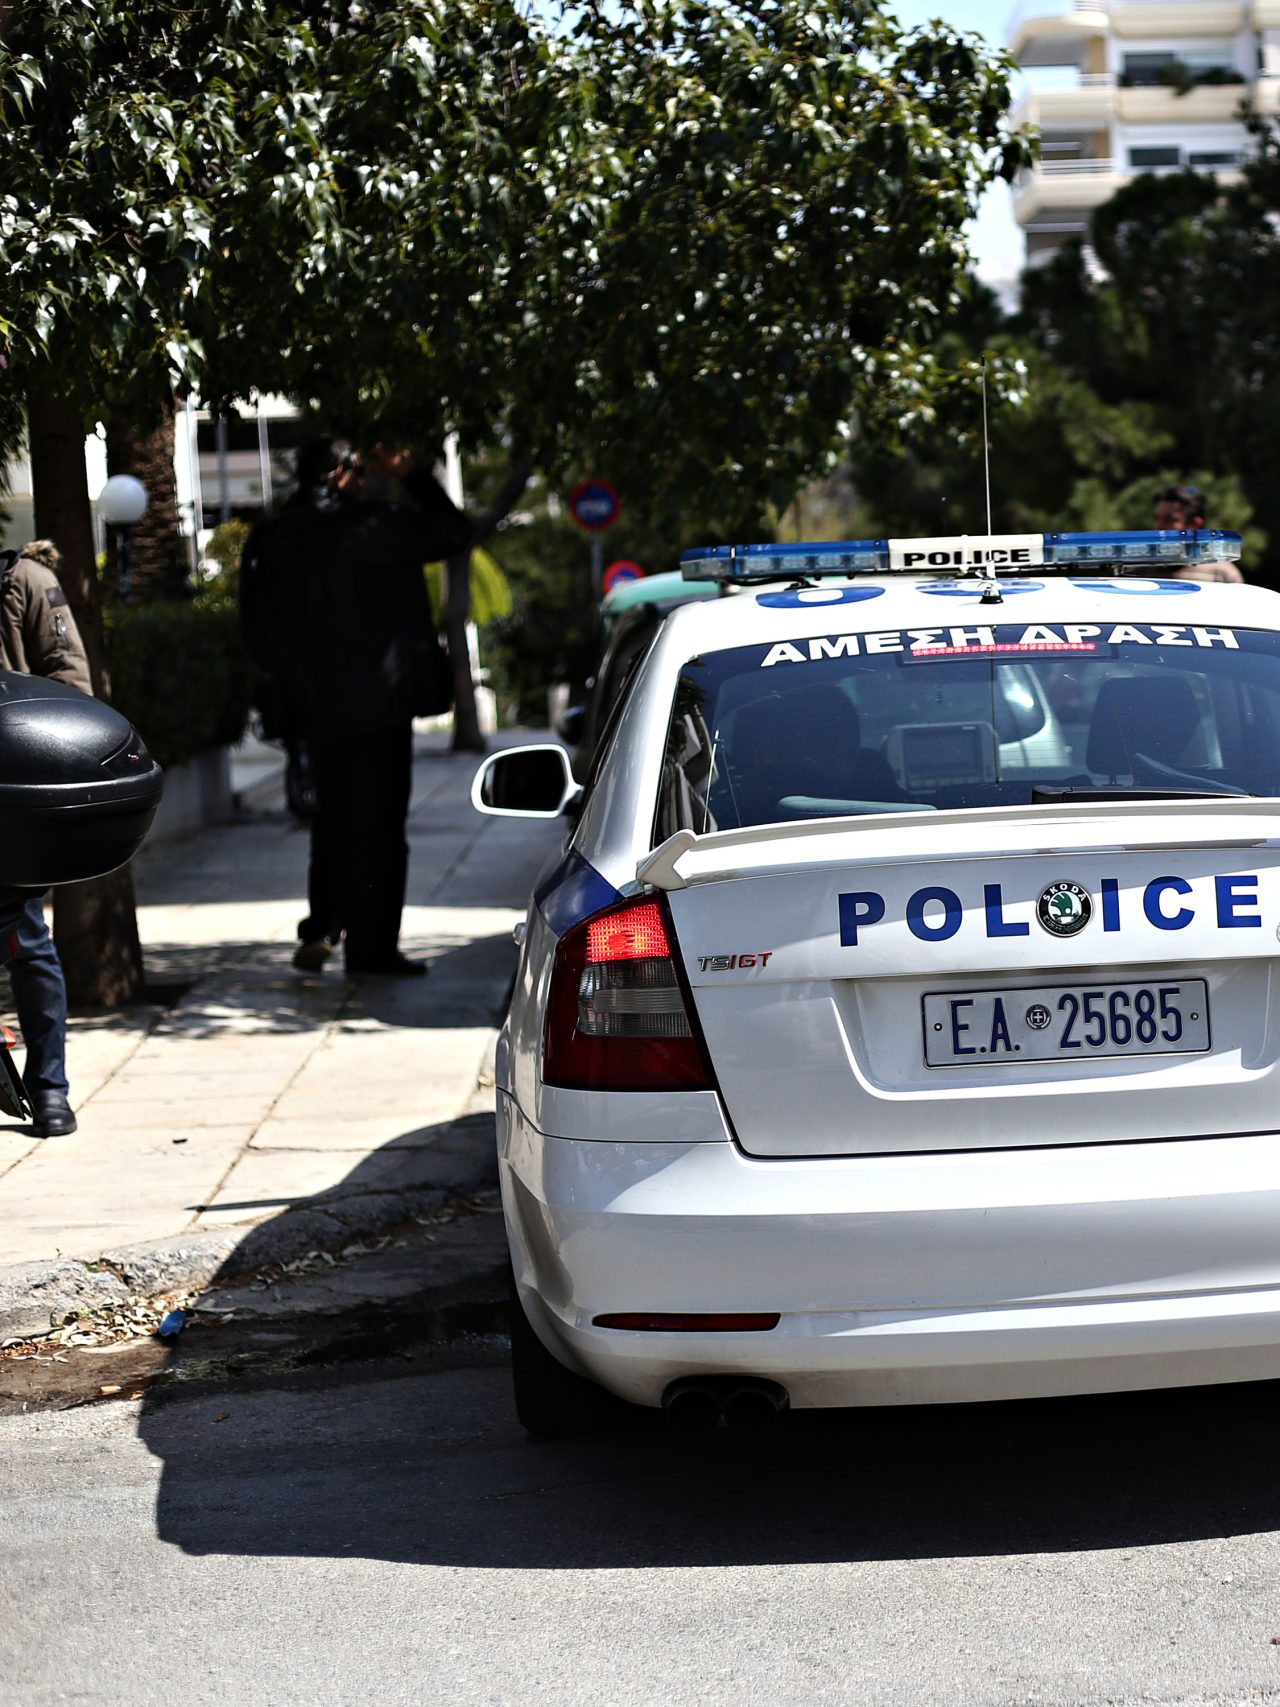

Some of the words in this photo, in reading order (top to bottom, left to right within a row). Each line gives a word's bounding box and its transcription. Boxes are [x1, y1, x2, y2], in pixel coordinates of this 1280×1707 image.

[903, 549, 1030, 566] POLICE
[838, 875, 1262, 947] POLICE
[1058, 987, 1183, 1049] 25685
